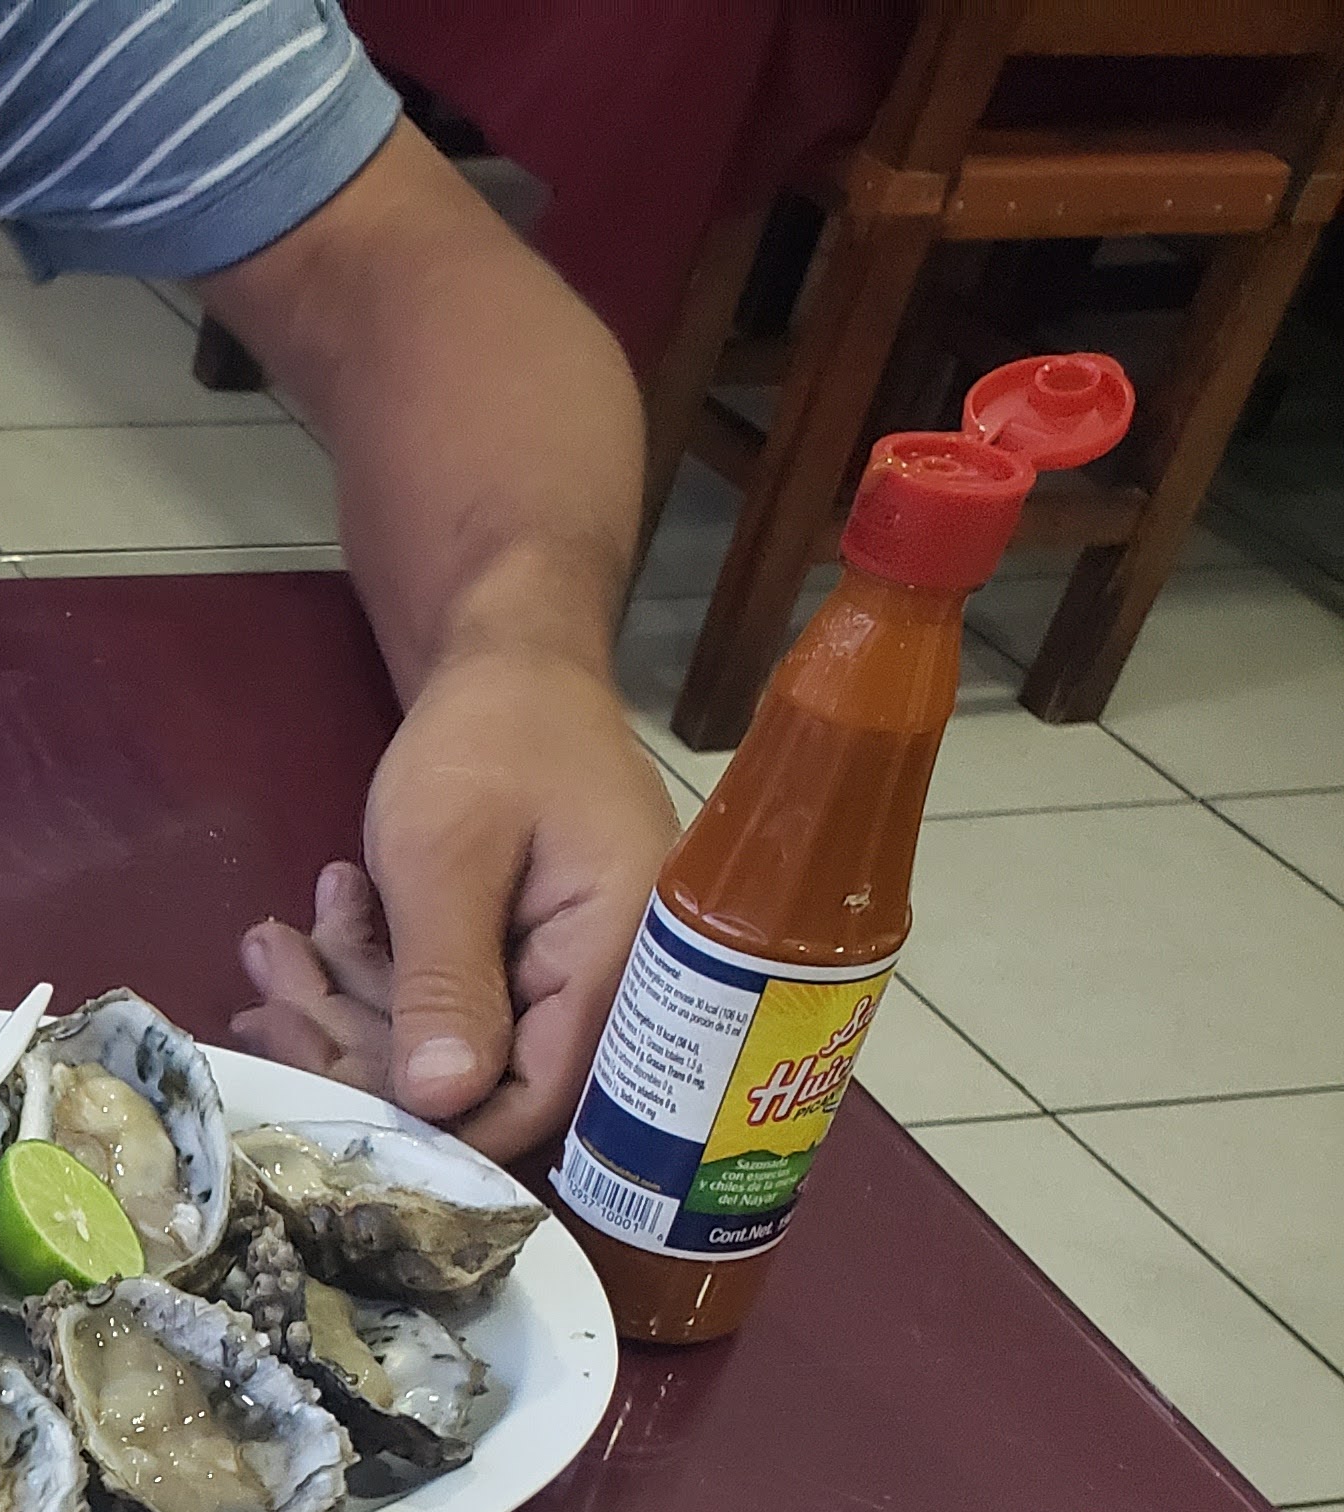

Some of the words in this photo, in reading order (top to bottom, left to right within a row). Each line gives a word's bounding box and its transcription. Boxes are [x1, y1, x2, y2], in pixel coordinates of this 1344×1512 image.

[705, 1001, 720, 1015] kcal
[677, 1007, 690, 1019] una
[714, 1021, 725, 1032] de
[725, 1023, 732, 1035] 5
[662, 1029, 677, 1043] kcal
[722, 1171, 744, 1181] con
[699, 1179, 708, 1192] y
[709, 1181, 745, 1193] chiles
[746, 1181, 761, 1192] de
[763, 1180, 773, 1191] la
[718, 1193, 738, 1205] del
